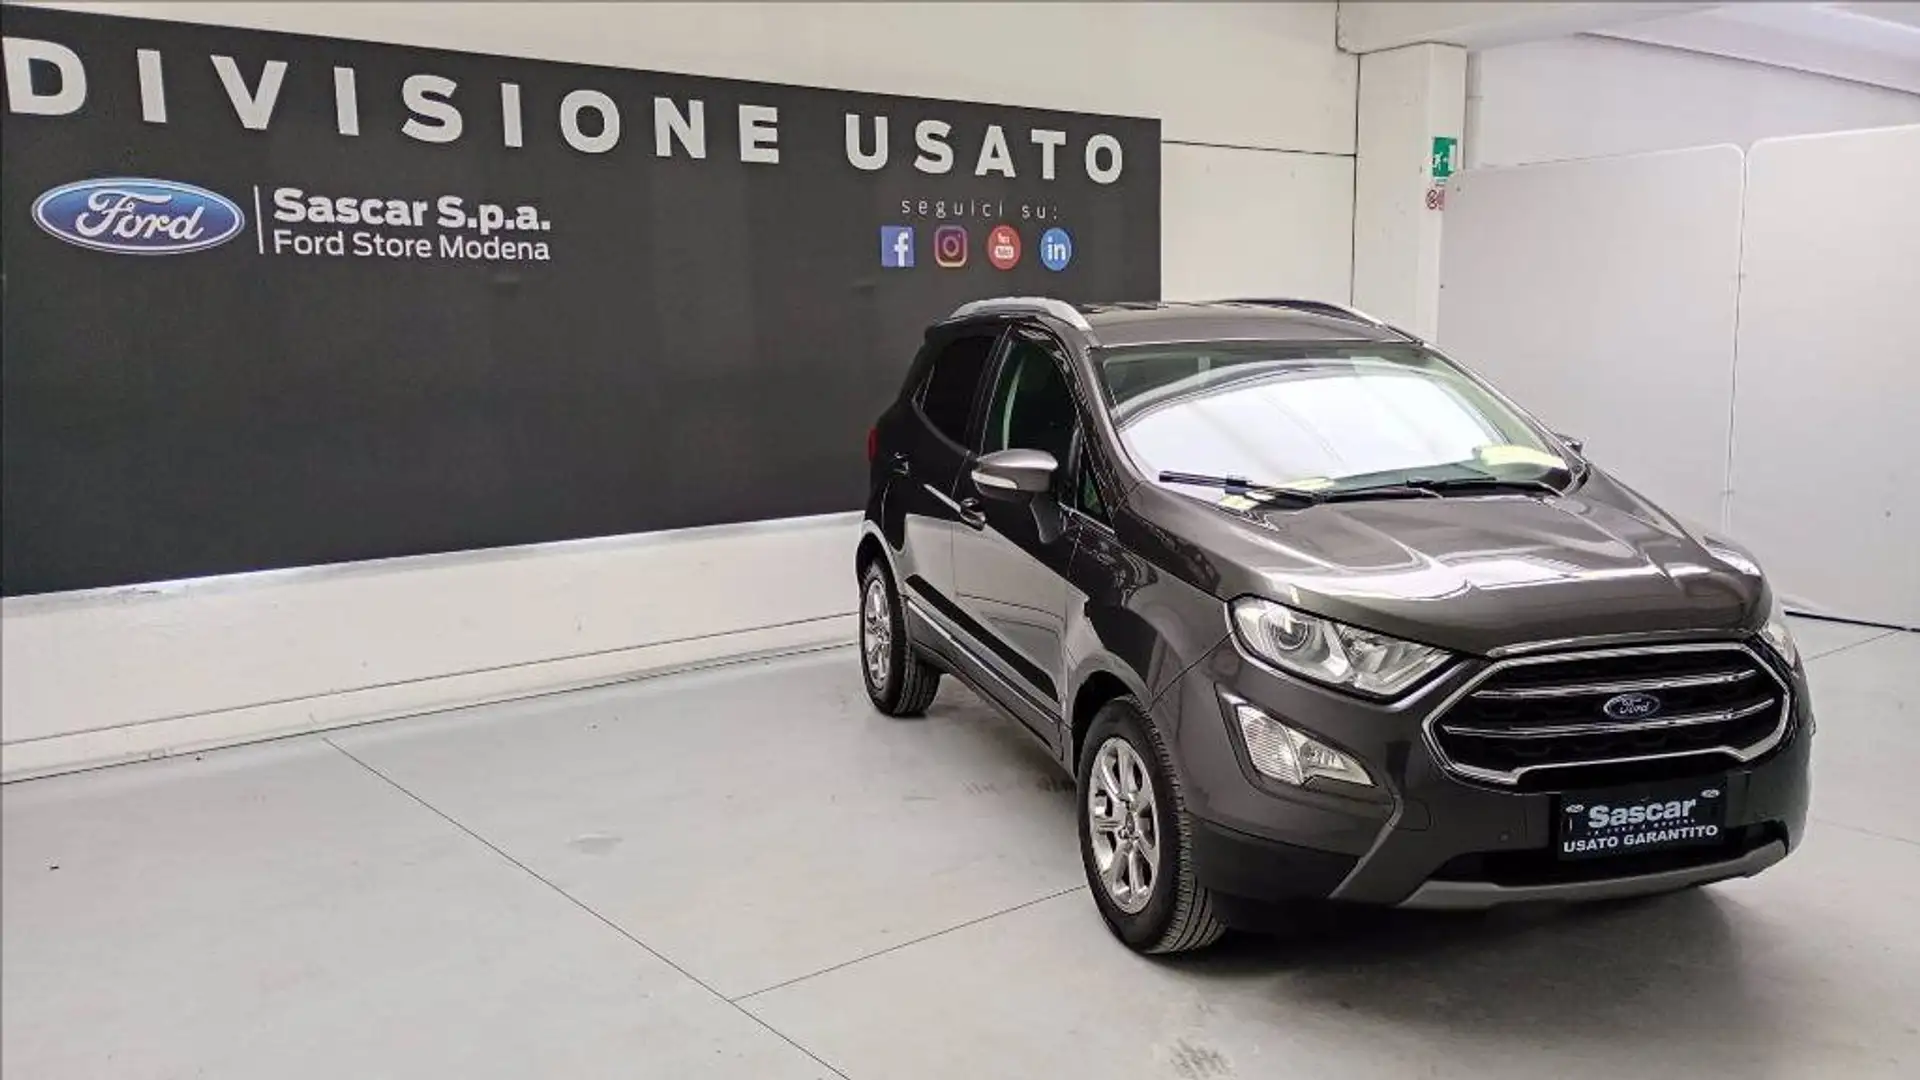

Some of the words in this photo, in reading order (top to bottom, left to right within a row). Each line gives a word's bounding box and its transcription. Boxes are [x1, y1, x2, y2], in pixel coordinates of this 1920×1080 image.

[2, 36, 780, 164] DIVISIONE
[845, 113, 1123, 183] USATO
[74, 189, 206, 241] Ford
[273, 187, 429, 228] Sascar
[436, 196, 551, 234] S.p.a.
[900, 199, 1003, 219] seguici
[1021, 205, 1058, 220] su:
[273, 229, 345, 256] Ford
[352, 232, 433, 259] Store
[439, 233, 551, 261] Modena
[1587, 799, 1697, 829] Sascar
[1563, 836, 1619, 853] USATO
[1623, 824, 1719, 845] GARANTITO
